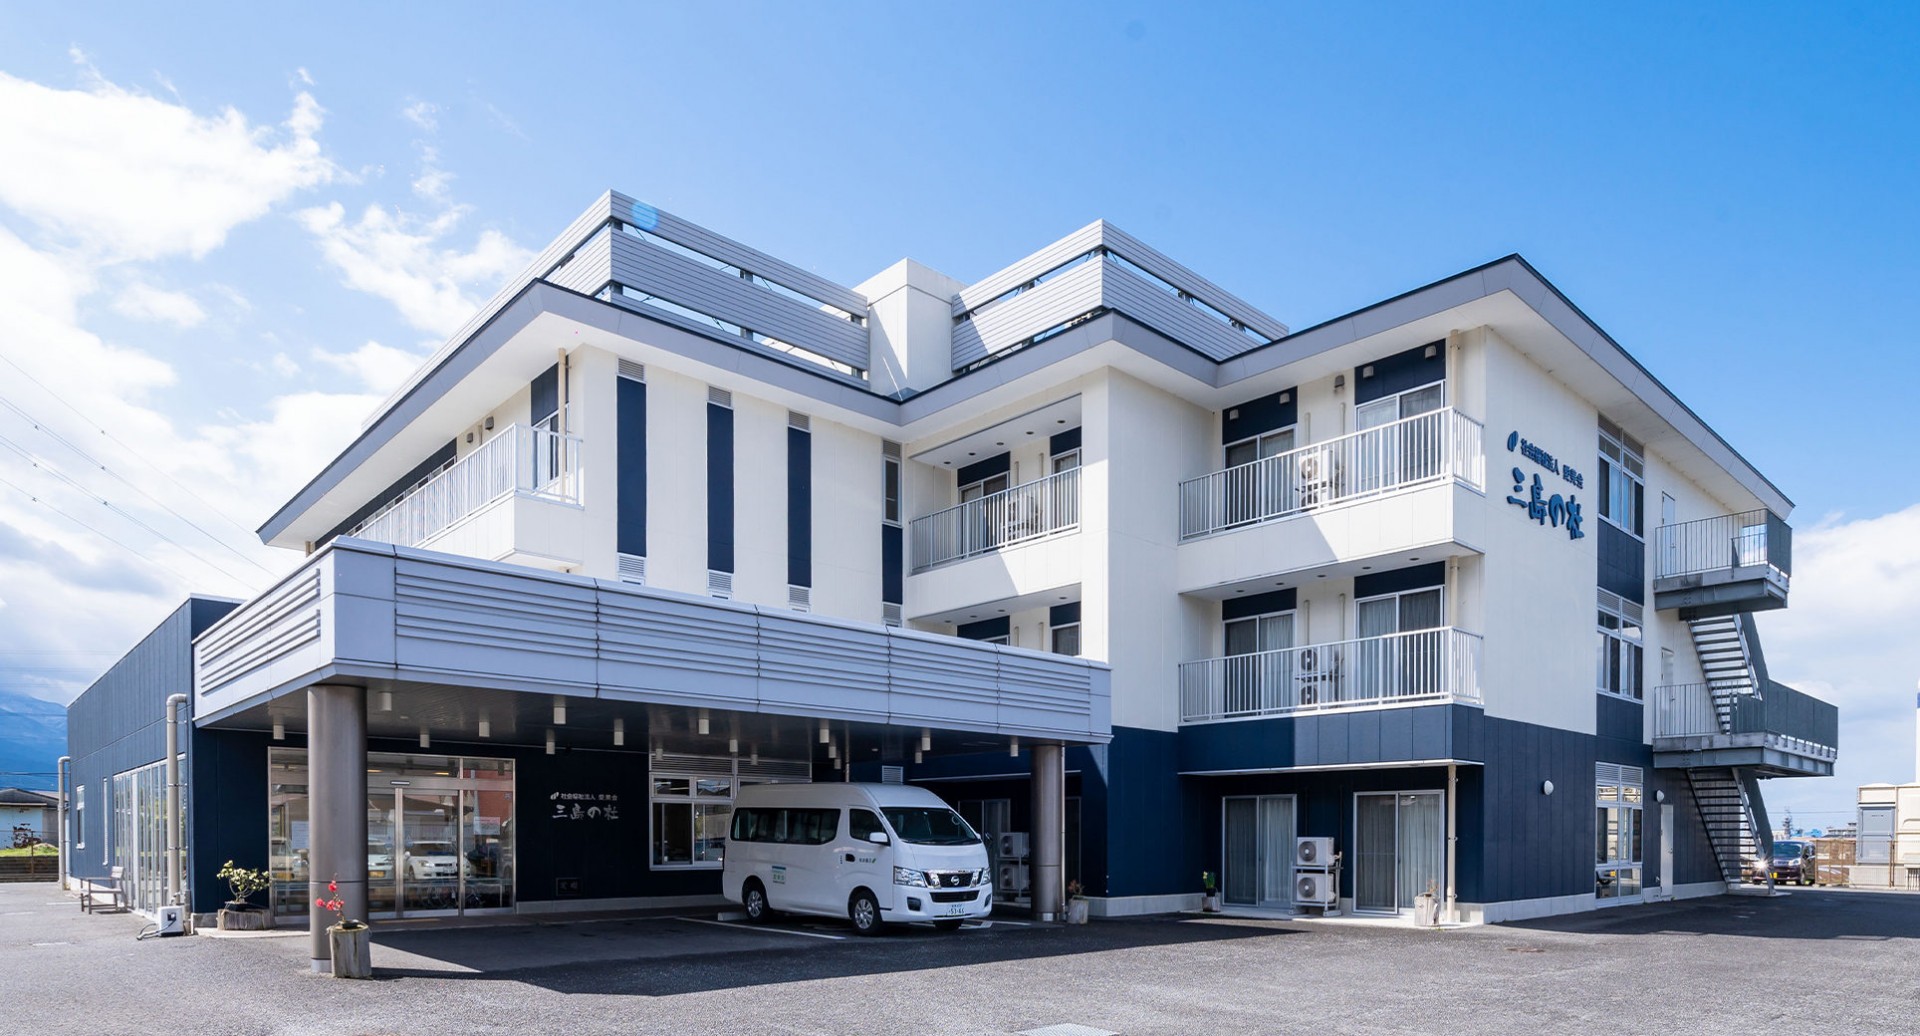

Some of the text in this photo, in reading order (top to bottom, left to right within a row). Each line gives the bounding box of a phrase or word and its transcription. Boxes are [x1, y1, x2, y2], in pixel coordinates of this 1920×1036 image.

[1506, 467, 1585, 540] 三島の杜
[551, 803, 619, 820] 三島の杜
